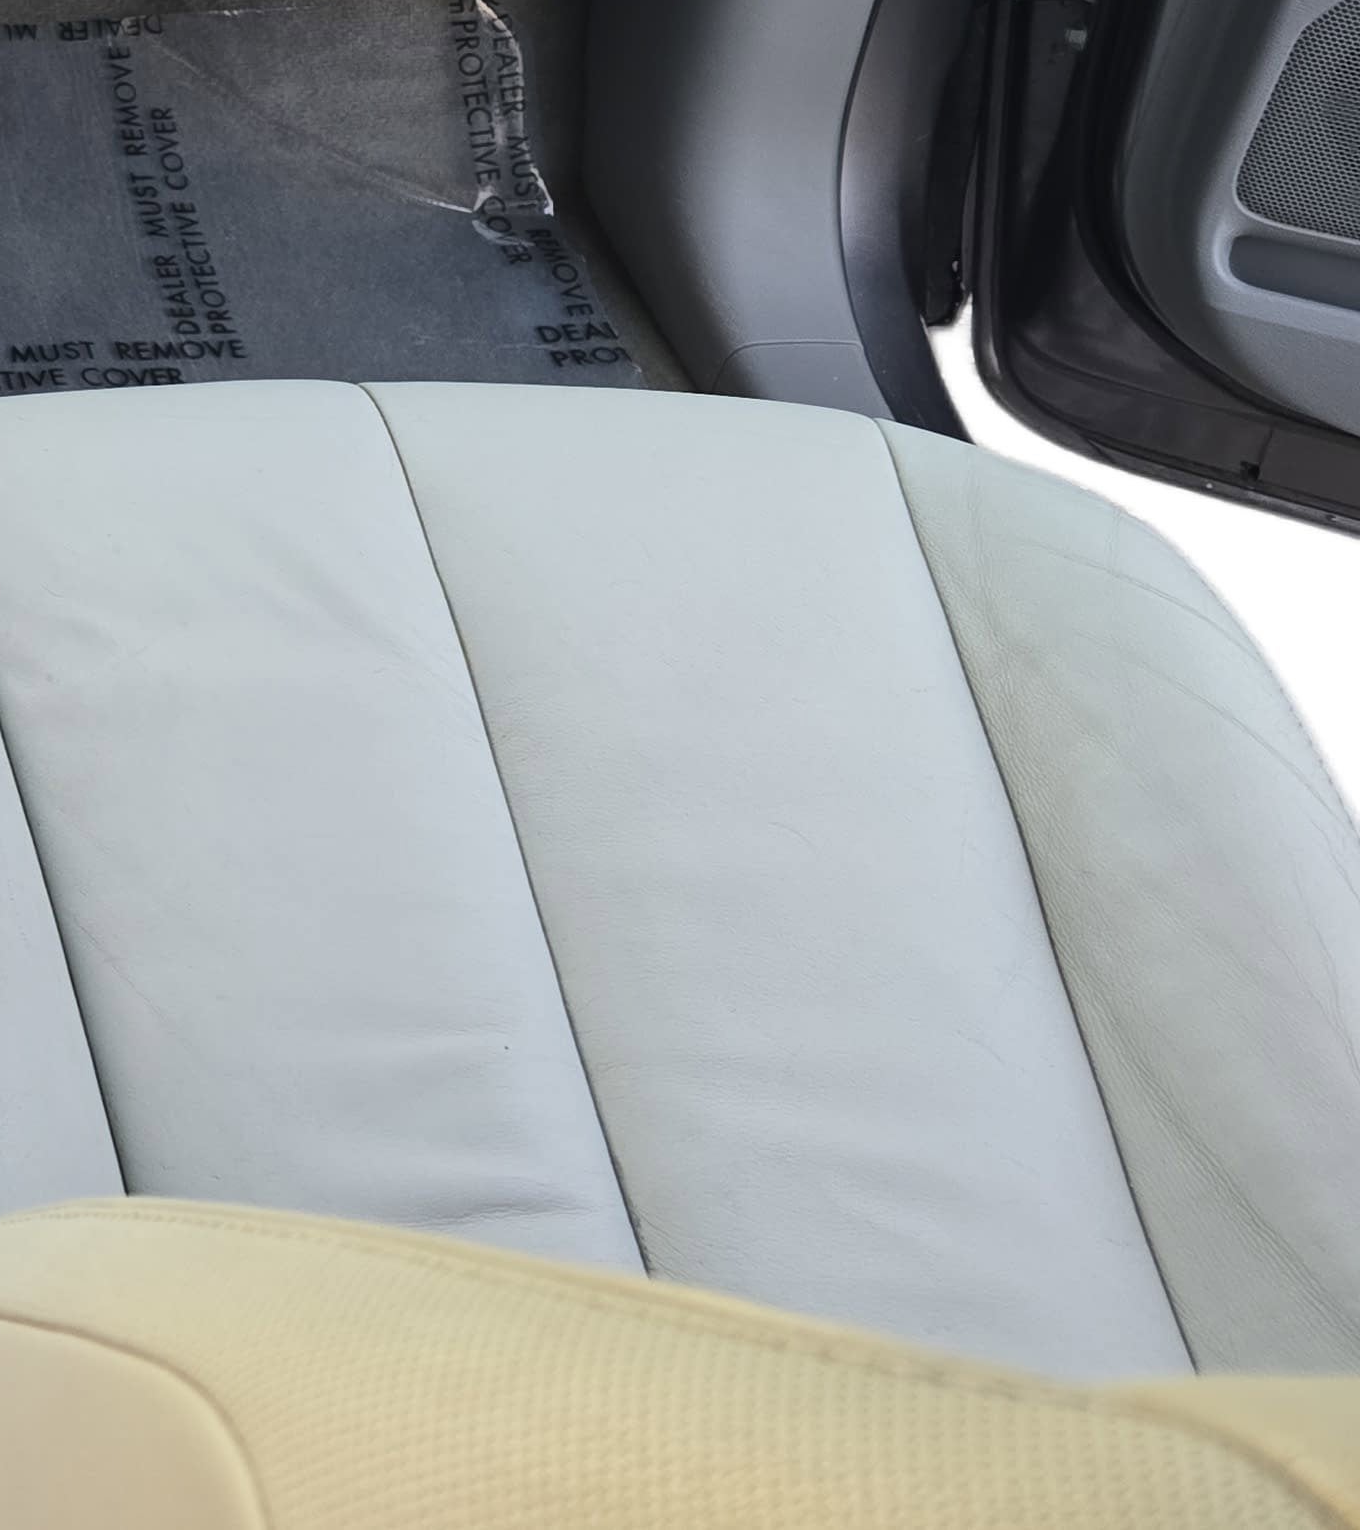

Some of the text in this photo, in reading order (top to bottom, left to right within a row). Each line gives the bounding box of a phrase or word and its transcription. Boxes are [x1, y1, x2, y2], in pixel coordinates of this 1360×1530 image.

[57, 13, 165, 43] DEALER
[453, 19, 502, 186] PROTECTIVE
[108, 45, 199, 337] DEALER MUST REMOVE
[150, 105, 235, 337] PROTECTIVE COVER
[526, 226, 595, 318] REMOVE
[10, 340, 96, 364] MUST
[114, 338, 247, 362] REMOVE
[82, 366, 186, 387] COVER
